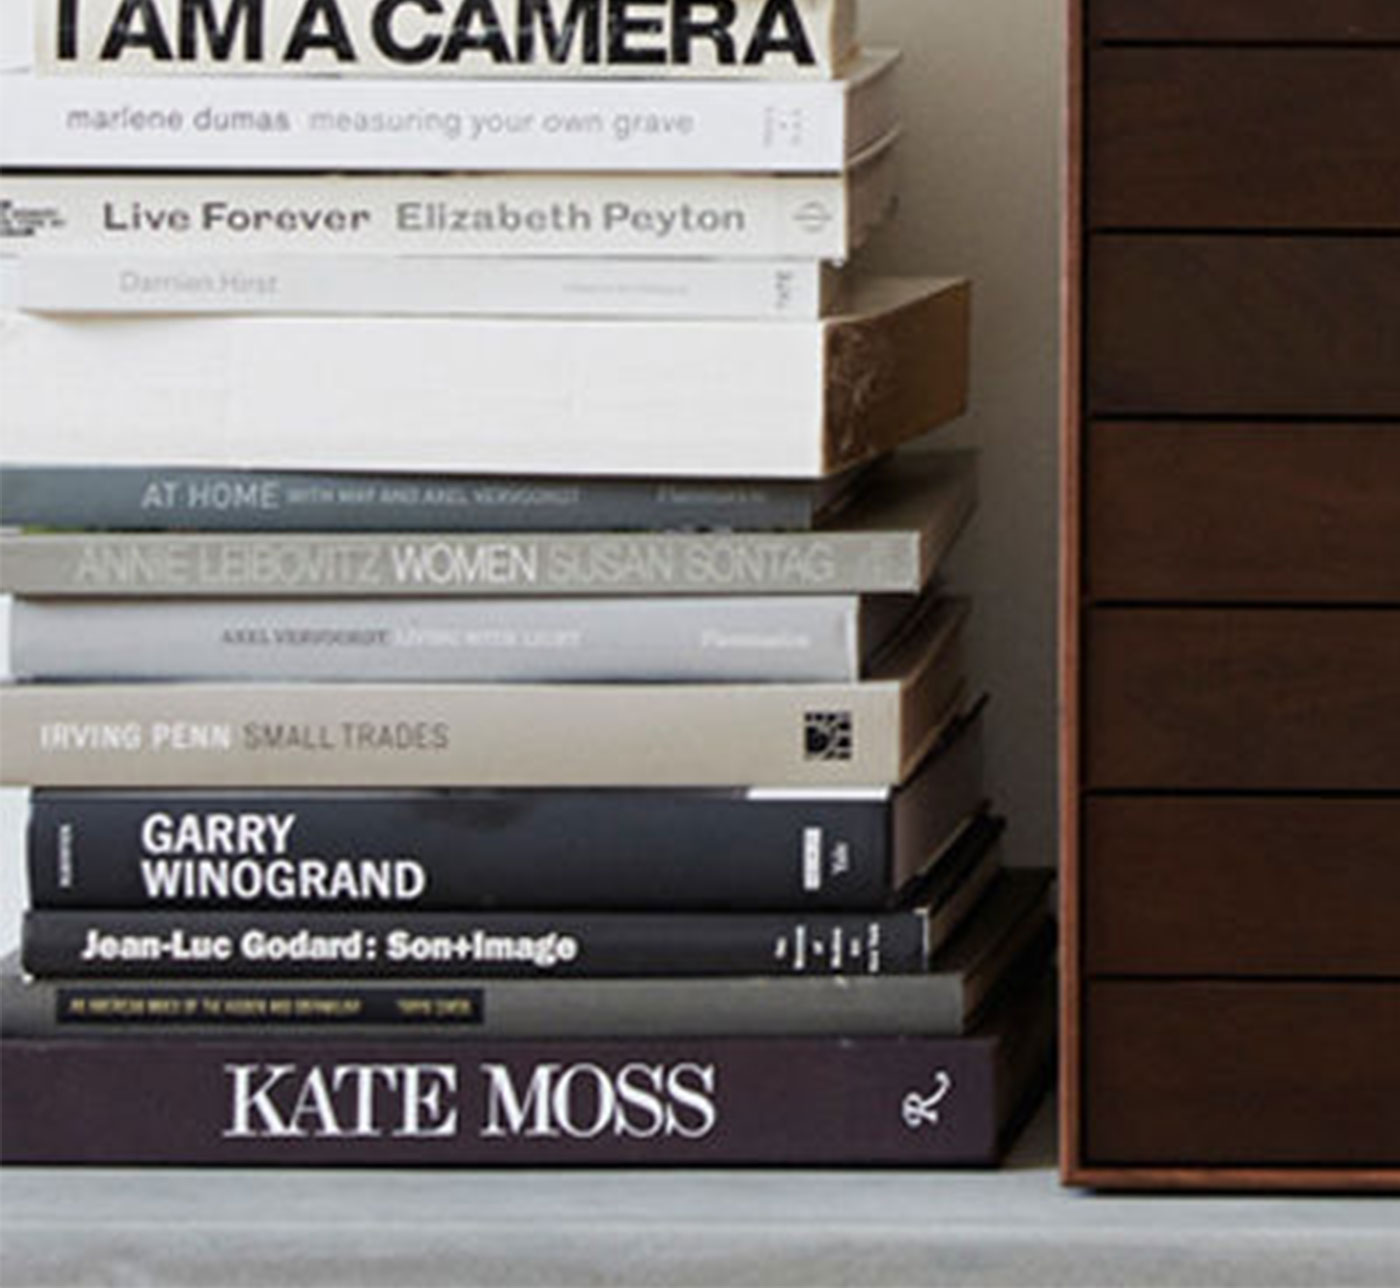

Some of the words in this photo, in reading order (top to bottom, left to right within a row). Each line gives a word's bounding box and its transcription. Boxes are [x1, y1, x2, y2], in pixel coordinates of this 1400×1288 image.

[66, 105, 184, 132] marlene
[193, 106, 290, 132] dumas
[308, 108, 461, 139] measuring
[469, 114, 535, 140] your
[542, 113, 602, 133] own
[613, 114, 695, 141] grave
[102, 202, 191, 231] Live
[201, 202, 370, 231] Forever
[396, 202, 591, 232] Elizabeth
[603, 202, 746, 237] Peyton
[141, 480, 175, 508] AT
[188, 480, 280, 508] HOME
[73, 544, 192, 583] ANNIE
[202, 544, 383, 583] LEIBOVITZ
[393, 544, 538, 583] WOMEN
[547, 544, 674, 582] SUSAN
[686, 542, 836, 582] SONTAG
[40, 723, 142, 750] IRVING
[151, 724, 233, 750] PENN
[243, 722, 334, 749] SMALL
[341, 722, 449, 749] TRADES
[141, 813, 296, 854] GARRY
[141, 860, 426, 899] WINOGRAND
[81, 930, 231, 961] Jean-Luc
[386, 930, 578, 966] Son+Image
[222, 1063, 458, 1138] KATE
[481, 1062, 717, 1138] MOSS
